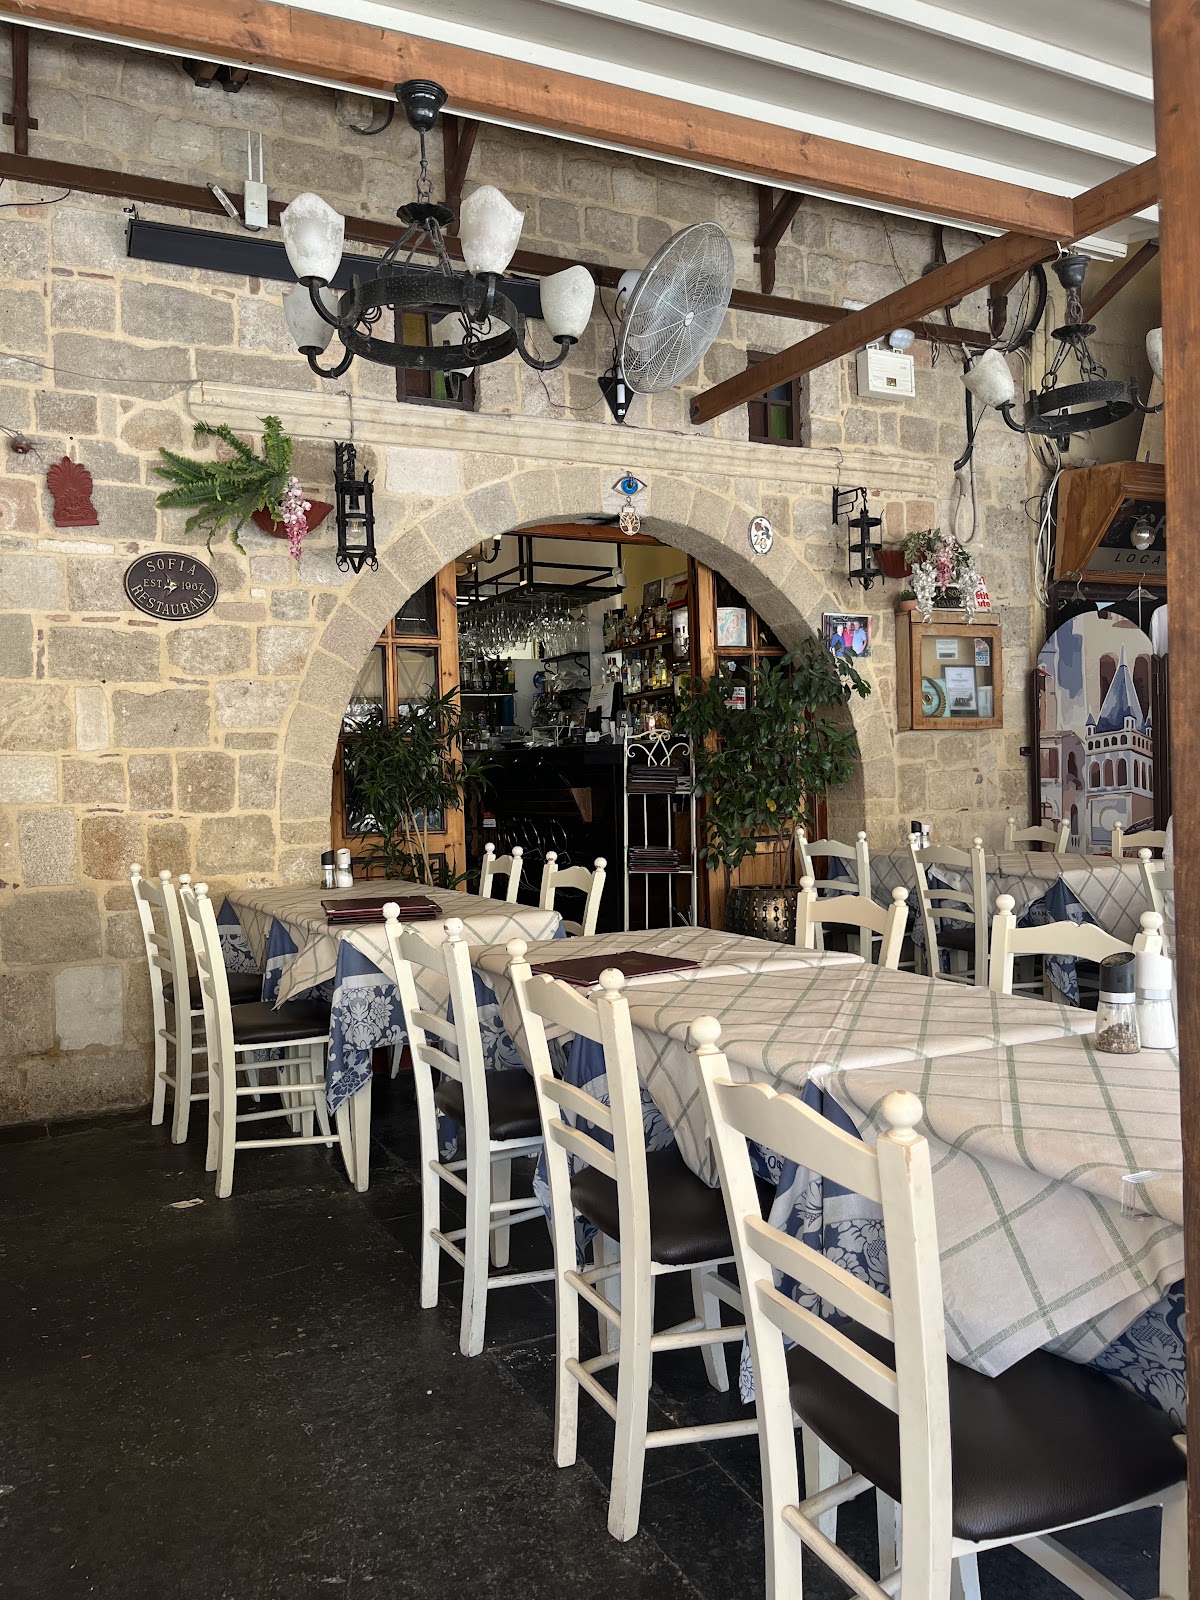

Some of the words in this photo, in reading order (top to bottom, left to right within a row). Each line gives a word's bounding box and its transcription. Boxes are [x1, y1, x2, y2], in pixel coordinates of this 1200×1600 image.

[1114, 552, 1161, 565] LOCA
[146, 558, 196, 575] SOFIA
[143, 579, 162, 588] EST
[182, 581, 204, 591] 1967
[131, 584, 213, 616] RESTAURANT
